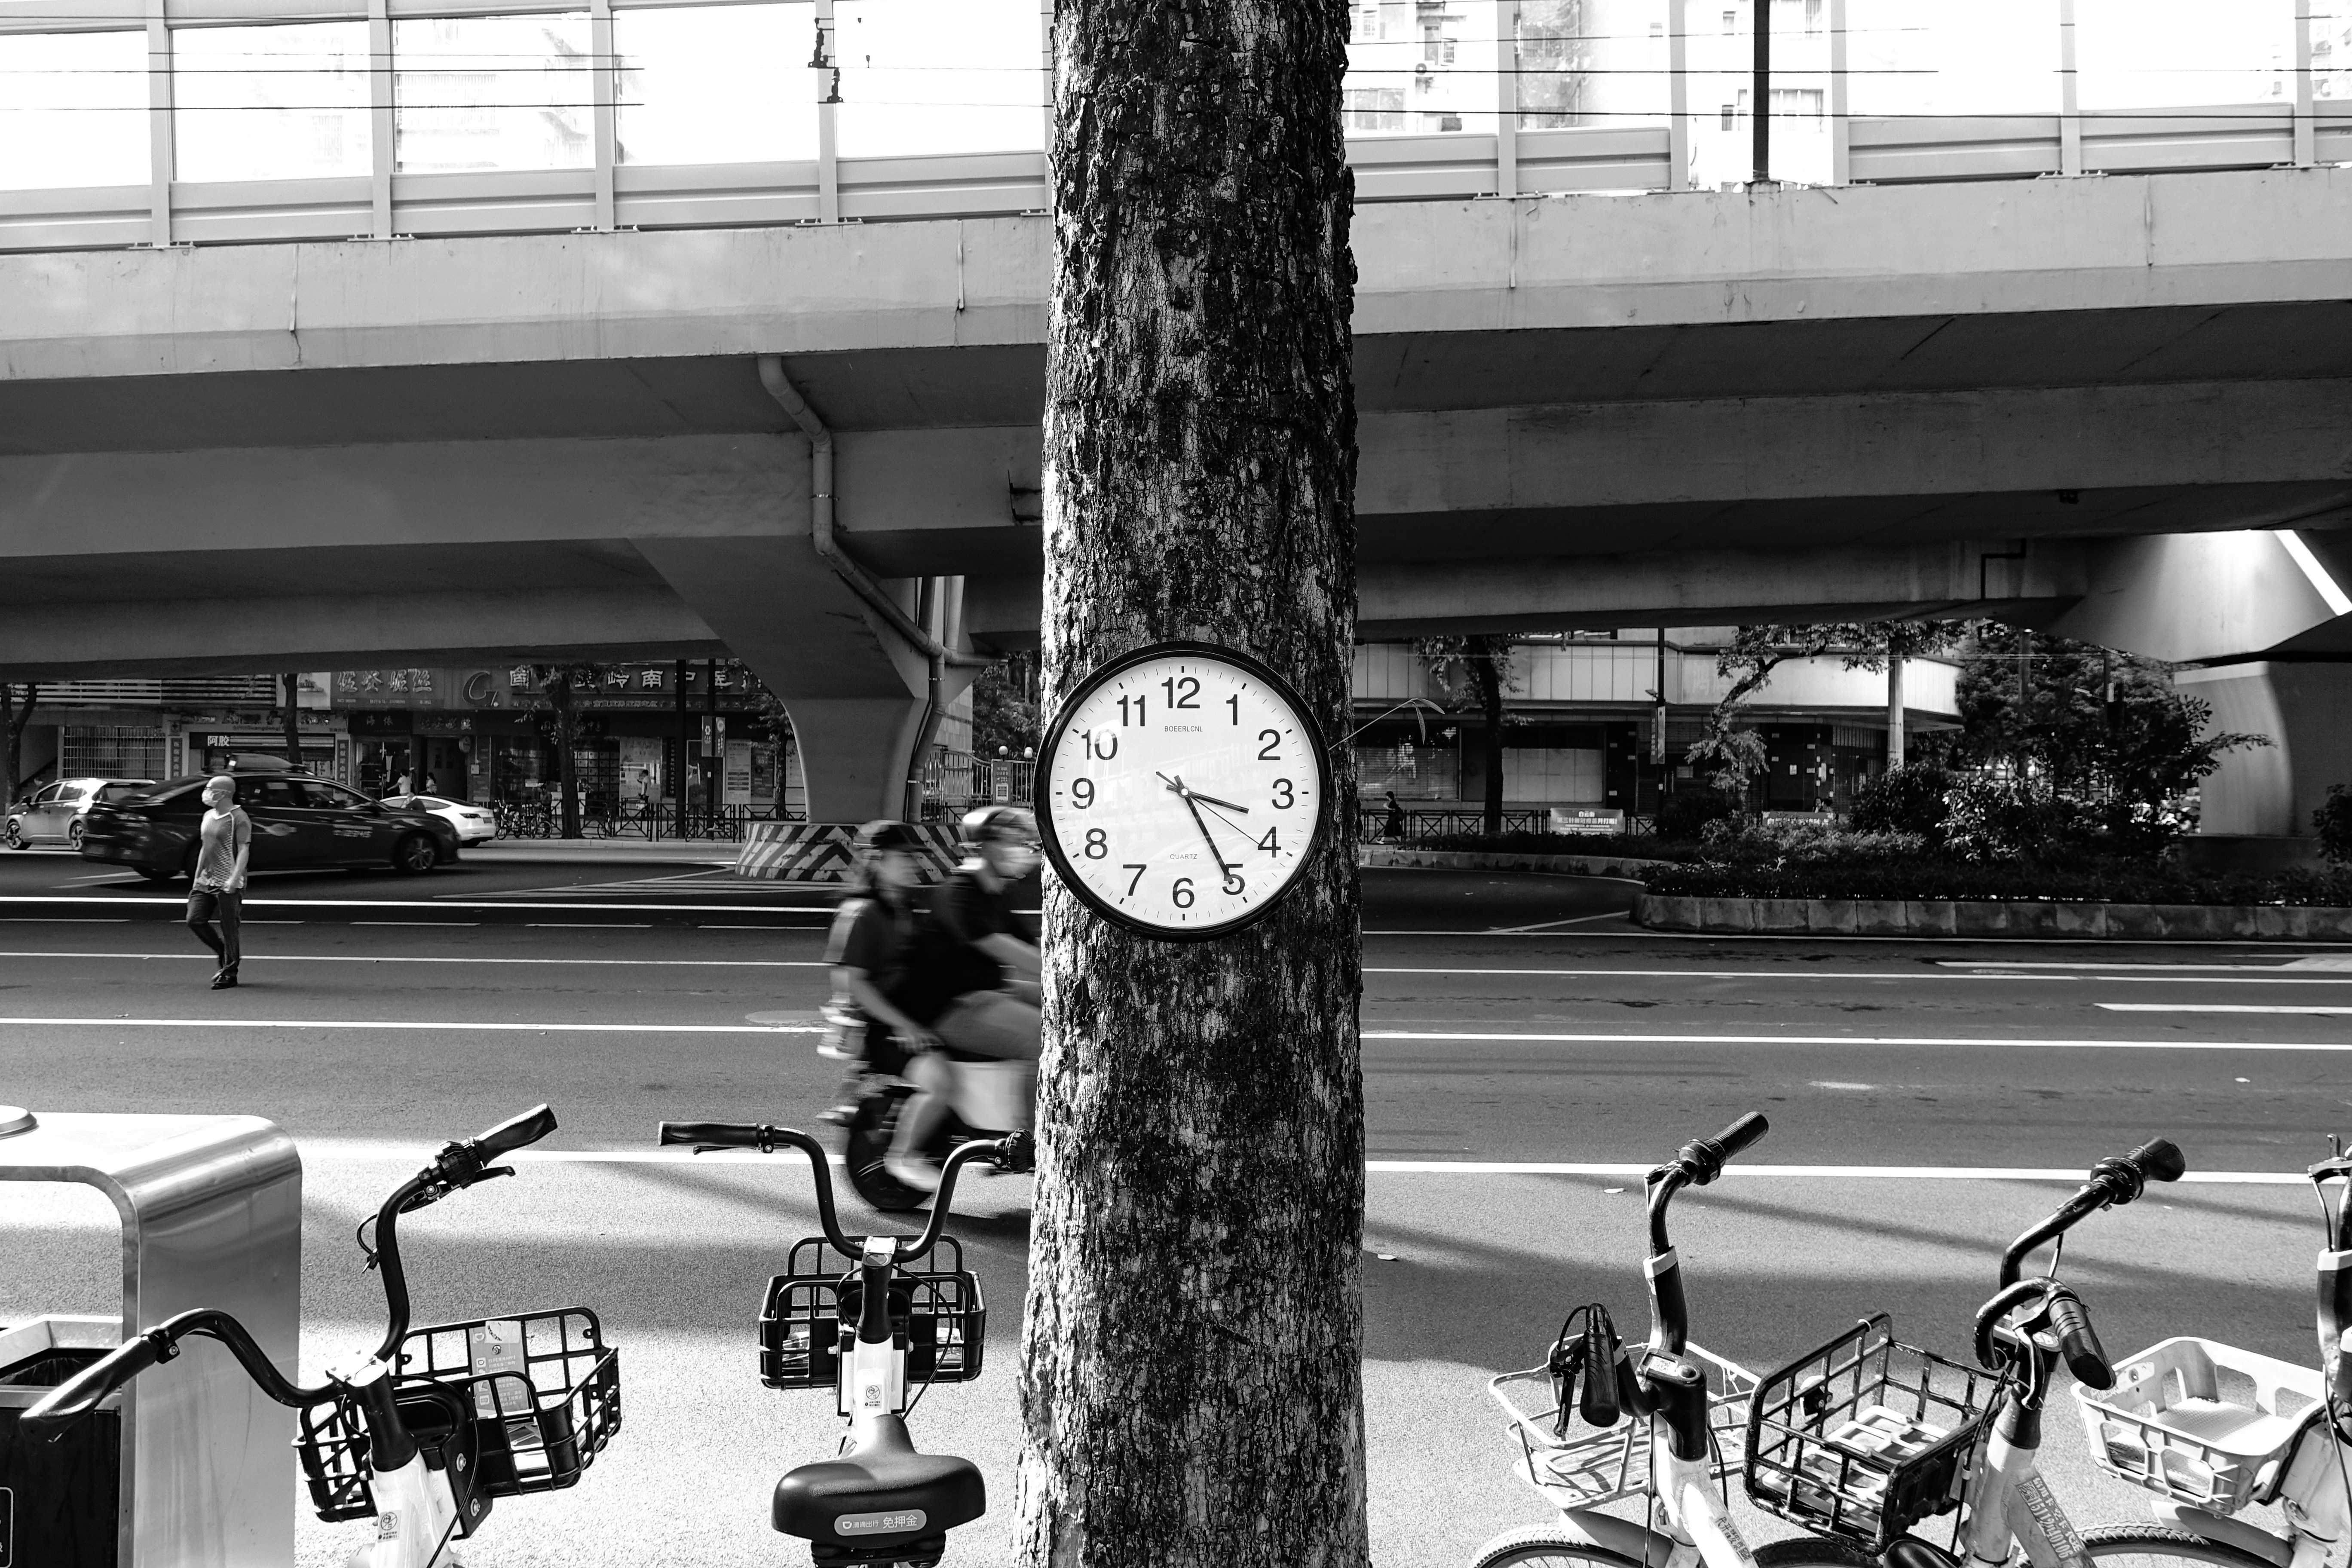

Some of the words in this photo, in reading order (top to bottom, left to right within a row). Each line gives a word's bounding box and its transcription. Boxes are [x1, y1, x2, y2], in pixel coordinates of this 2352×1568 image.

[1161, 677, 1200, 709] 12
[1117, 695, 1145, 726] 11
[1226, 694, 1237, 726] 1
[207, 735, 230, 747] 阿胶
[1081, 729, 1118, 760] 10
[1257, 729, 1281, 761] 2
[1071, 778, 1094, 809] 9
[1271, 778, 1294, 809] 3
[1084, 828, 1108, 860] 8
[1257, 827, 1281, 858] 4
[1123, 864, 1147, 896] 7
[1172, 877, 1195, 909] 6
[1222, 864, 1245, 895] 5
[853, 1520, 879, 1528] 滴滴出行
[883, 1514, 918, 1529] 免押金
